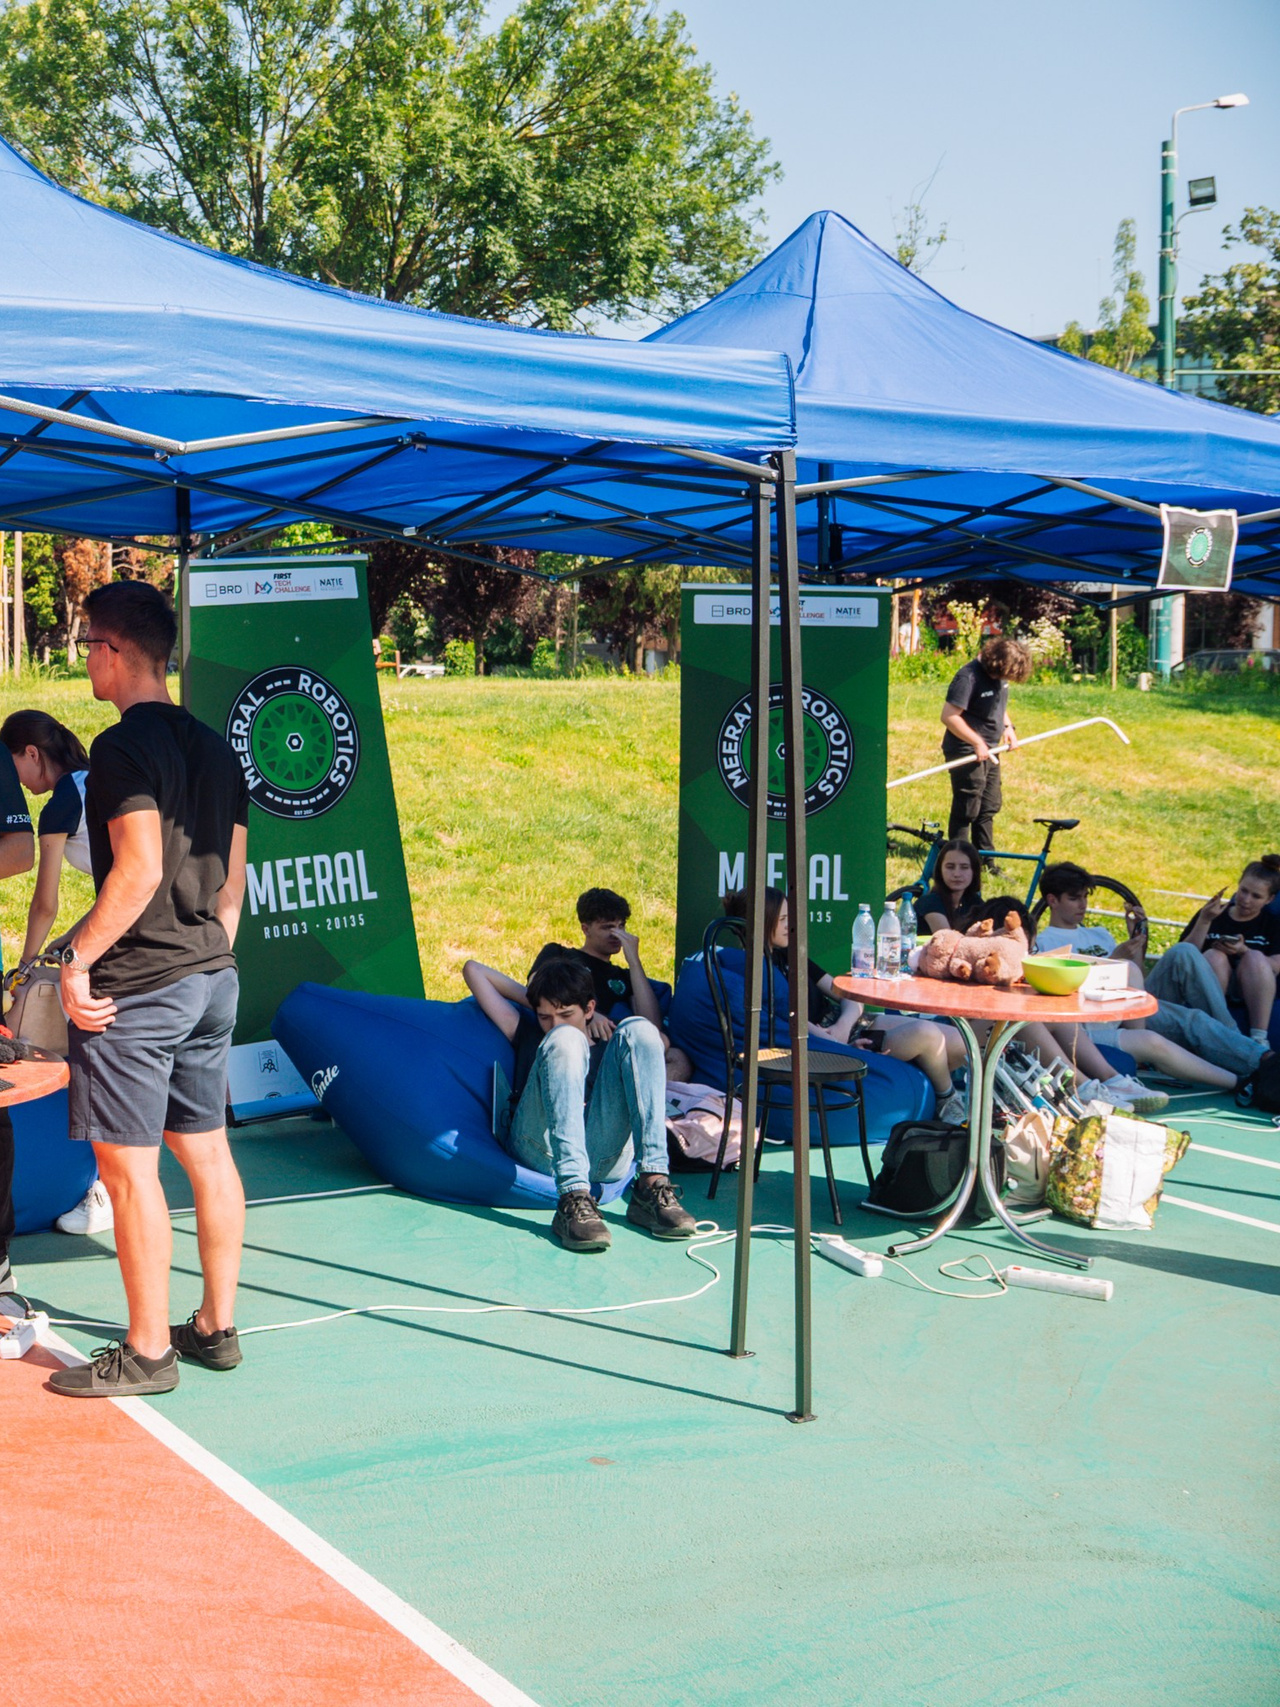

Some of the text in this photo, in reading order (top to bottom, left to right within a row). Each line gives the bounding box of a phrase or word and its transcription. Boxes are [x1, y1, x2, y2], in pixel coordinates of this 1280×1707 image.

[273, 572, 292, 580] FIRST
[219, 585, 243, 595] BRD
[274, 586, 311, 594] CHALLENGE
[726, 606, 751, 616] BRD
[231, 673, 354, 791] MEERAL ROBOTICS
[801, 691, 848, 796] ROBOTICS
[245, 849, 378, 916] MEERAL
[718, 851, 849, 901] MEAL
[326, 913, 365, 931] 20135
[809, 911, 832, 923] 135
